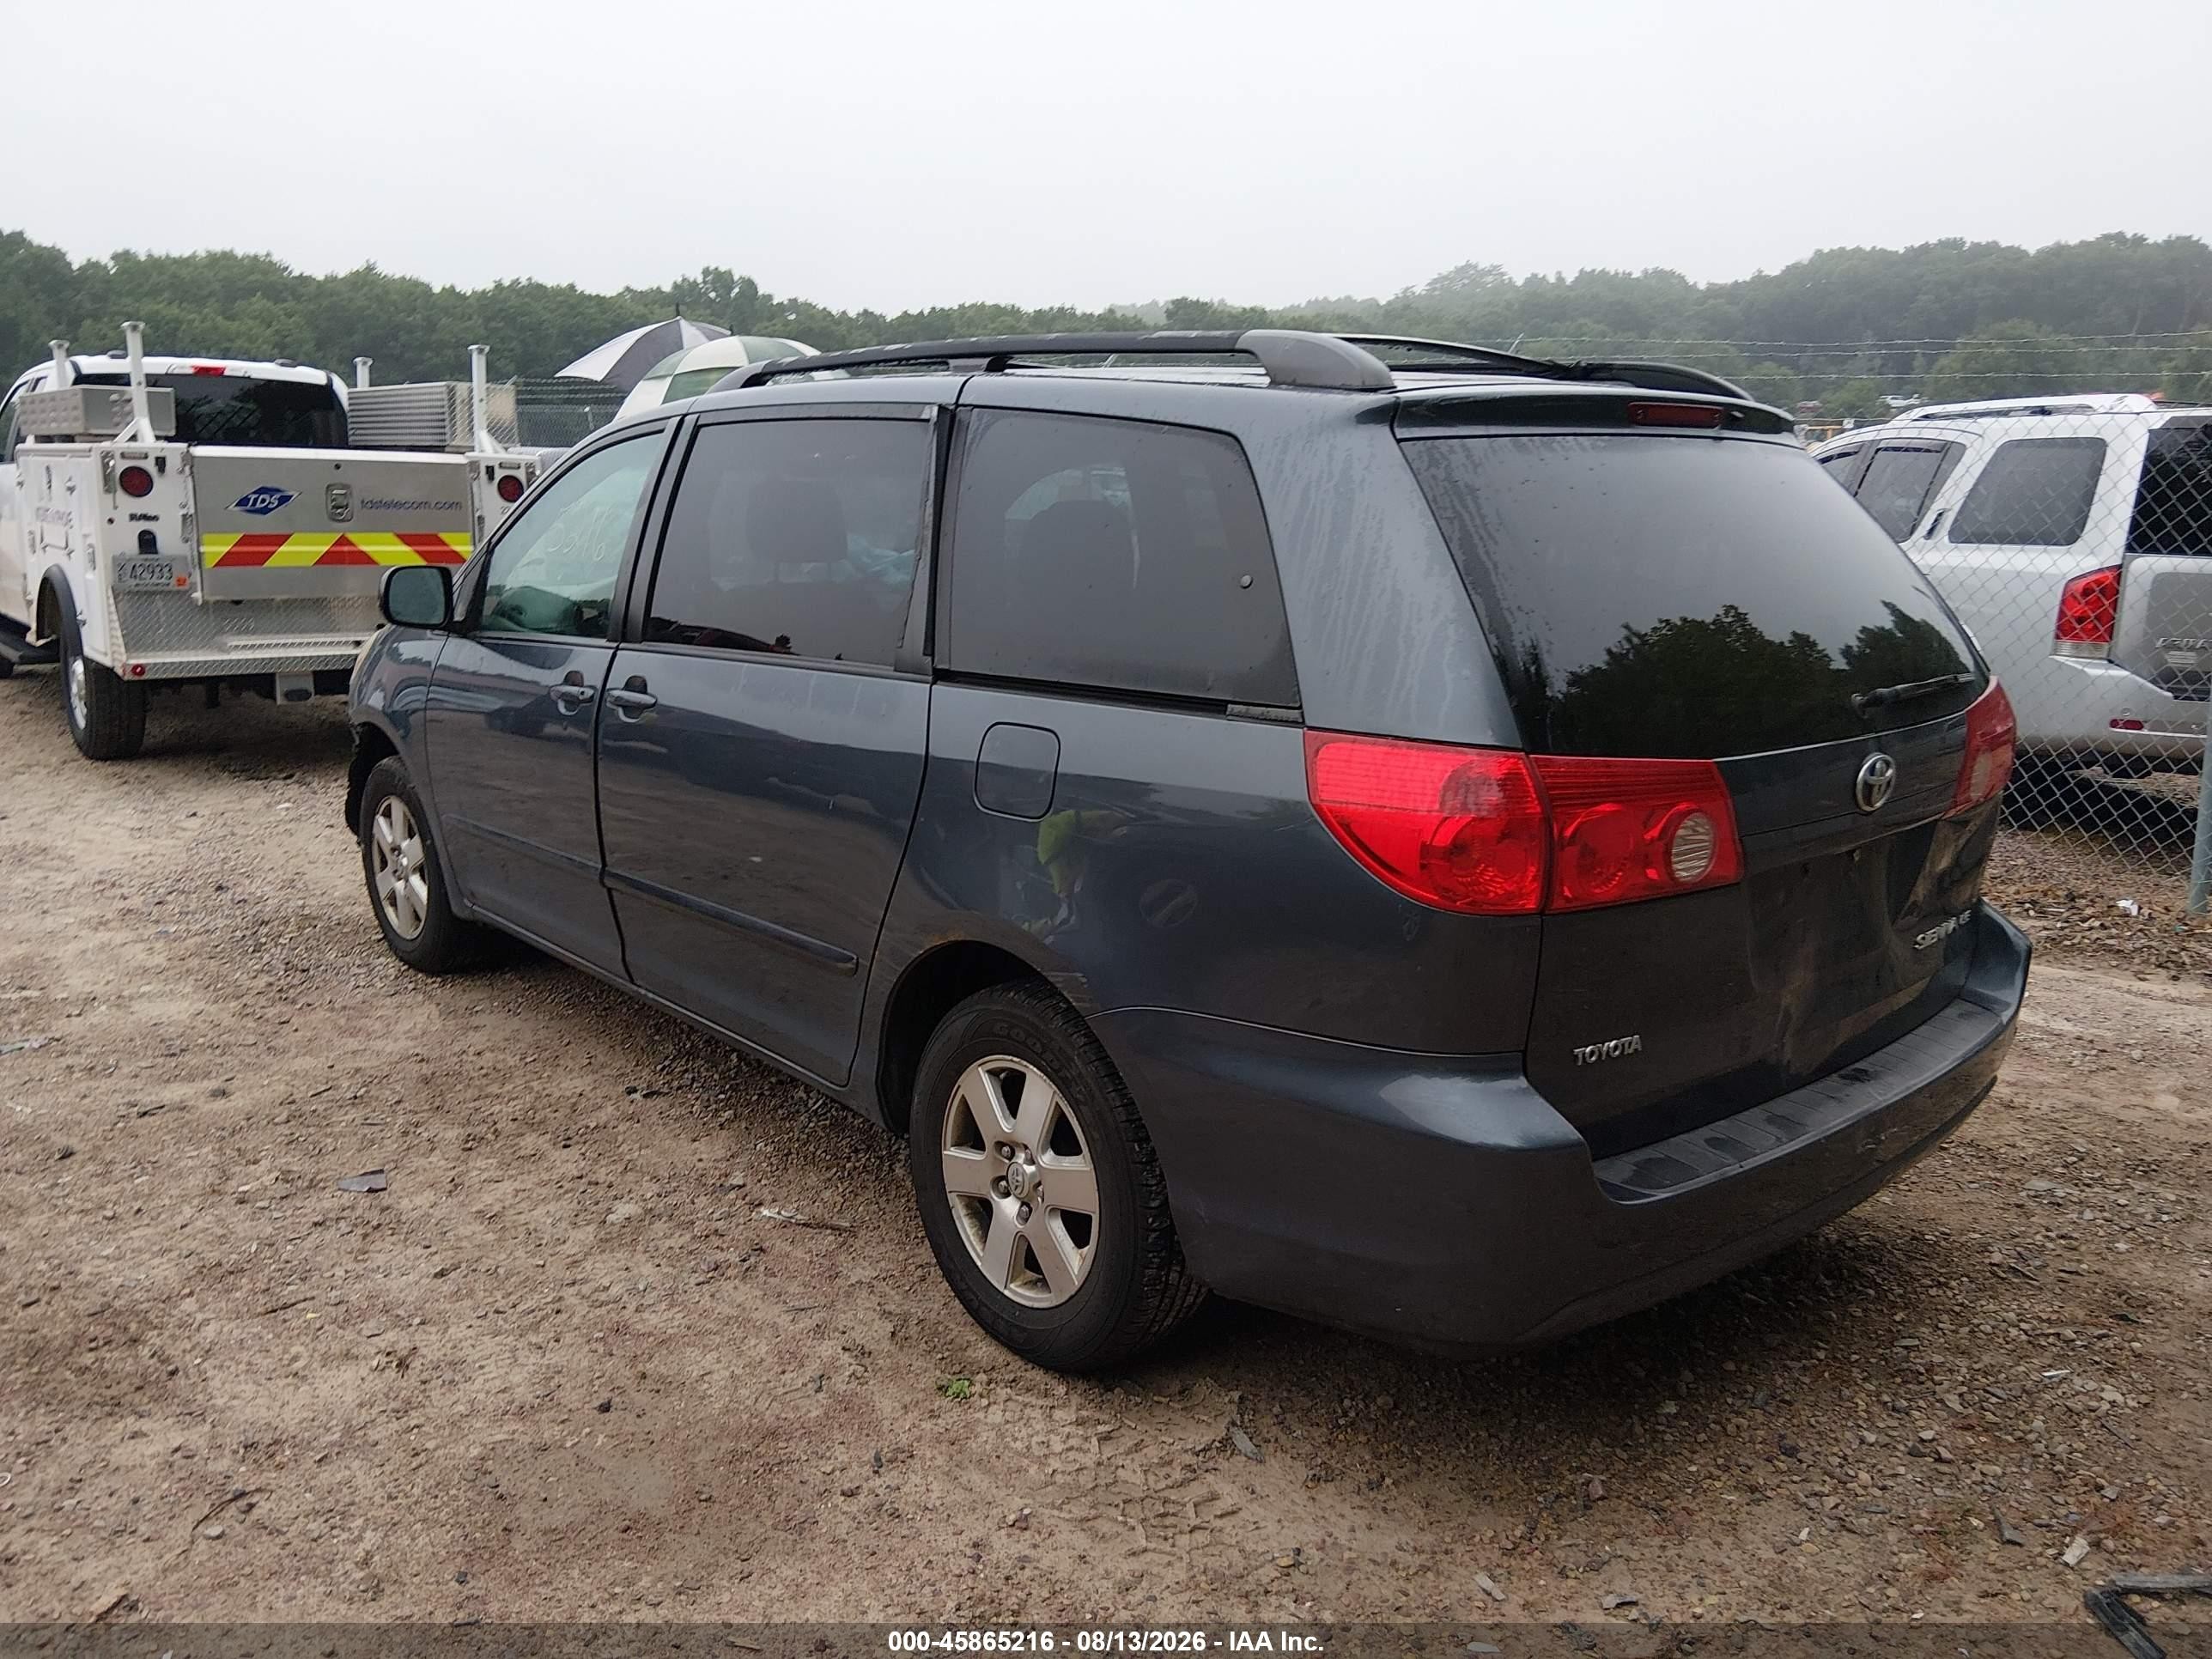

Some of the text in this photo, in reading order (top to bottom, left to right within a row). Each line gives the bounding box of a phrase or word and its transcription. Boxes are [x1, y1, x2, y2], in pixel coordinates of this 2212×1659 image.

[246, 493, 282, 509] TDS
[360, 497, 463, 512] tdstelecom.com
[129, 562, 173, 581] 42933
[1572, 1034, 1643, 1066] TOYOTA
